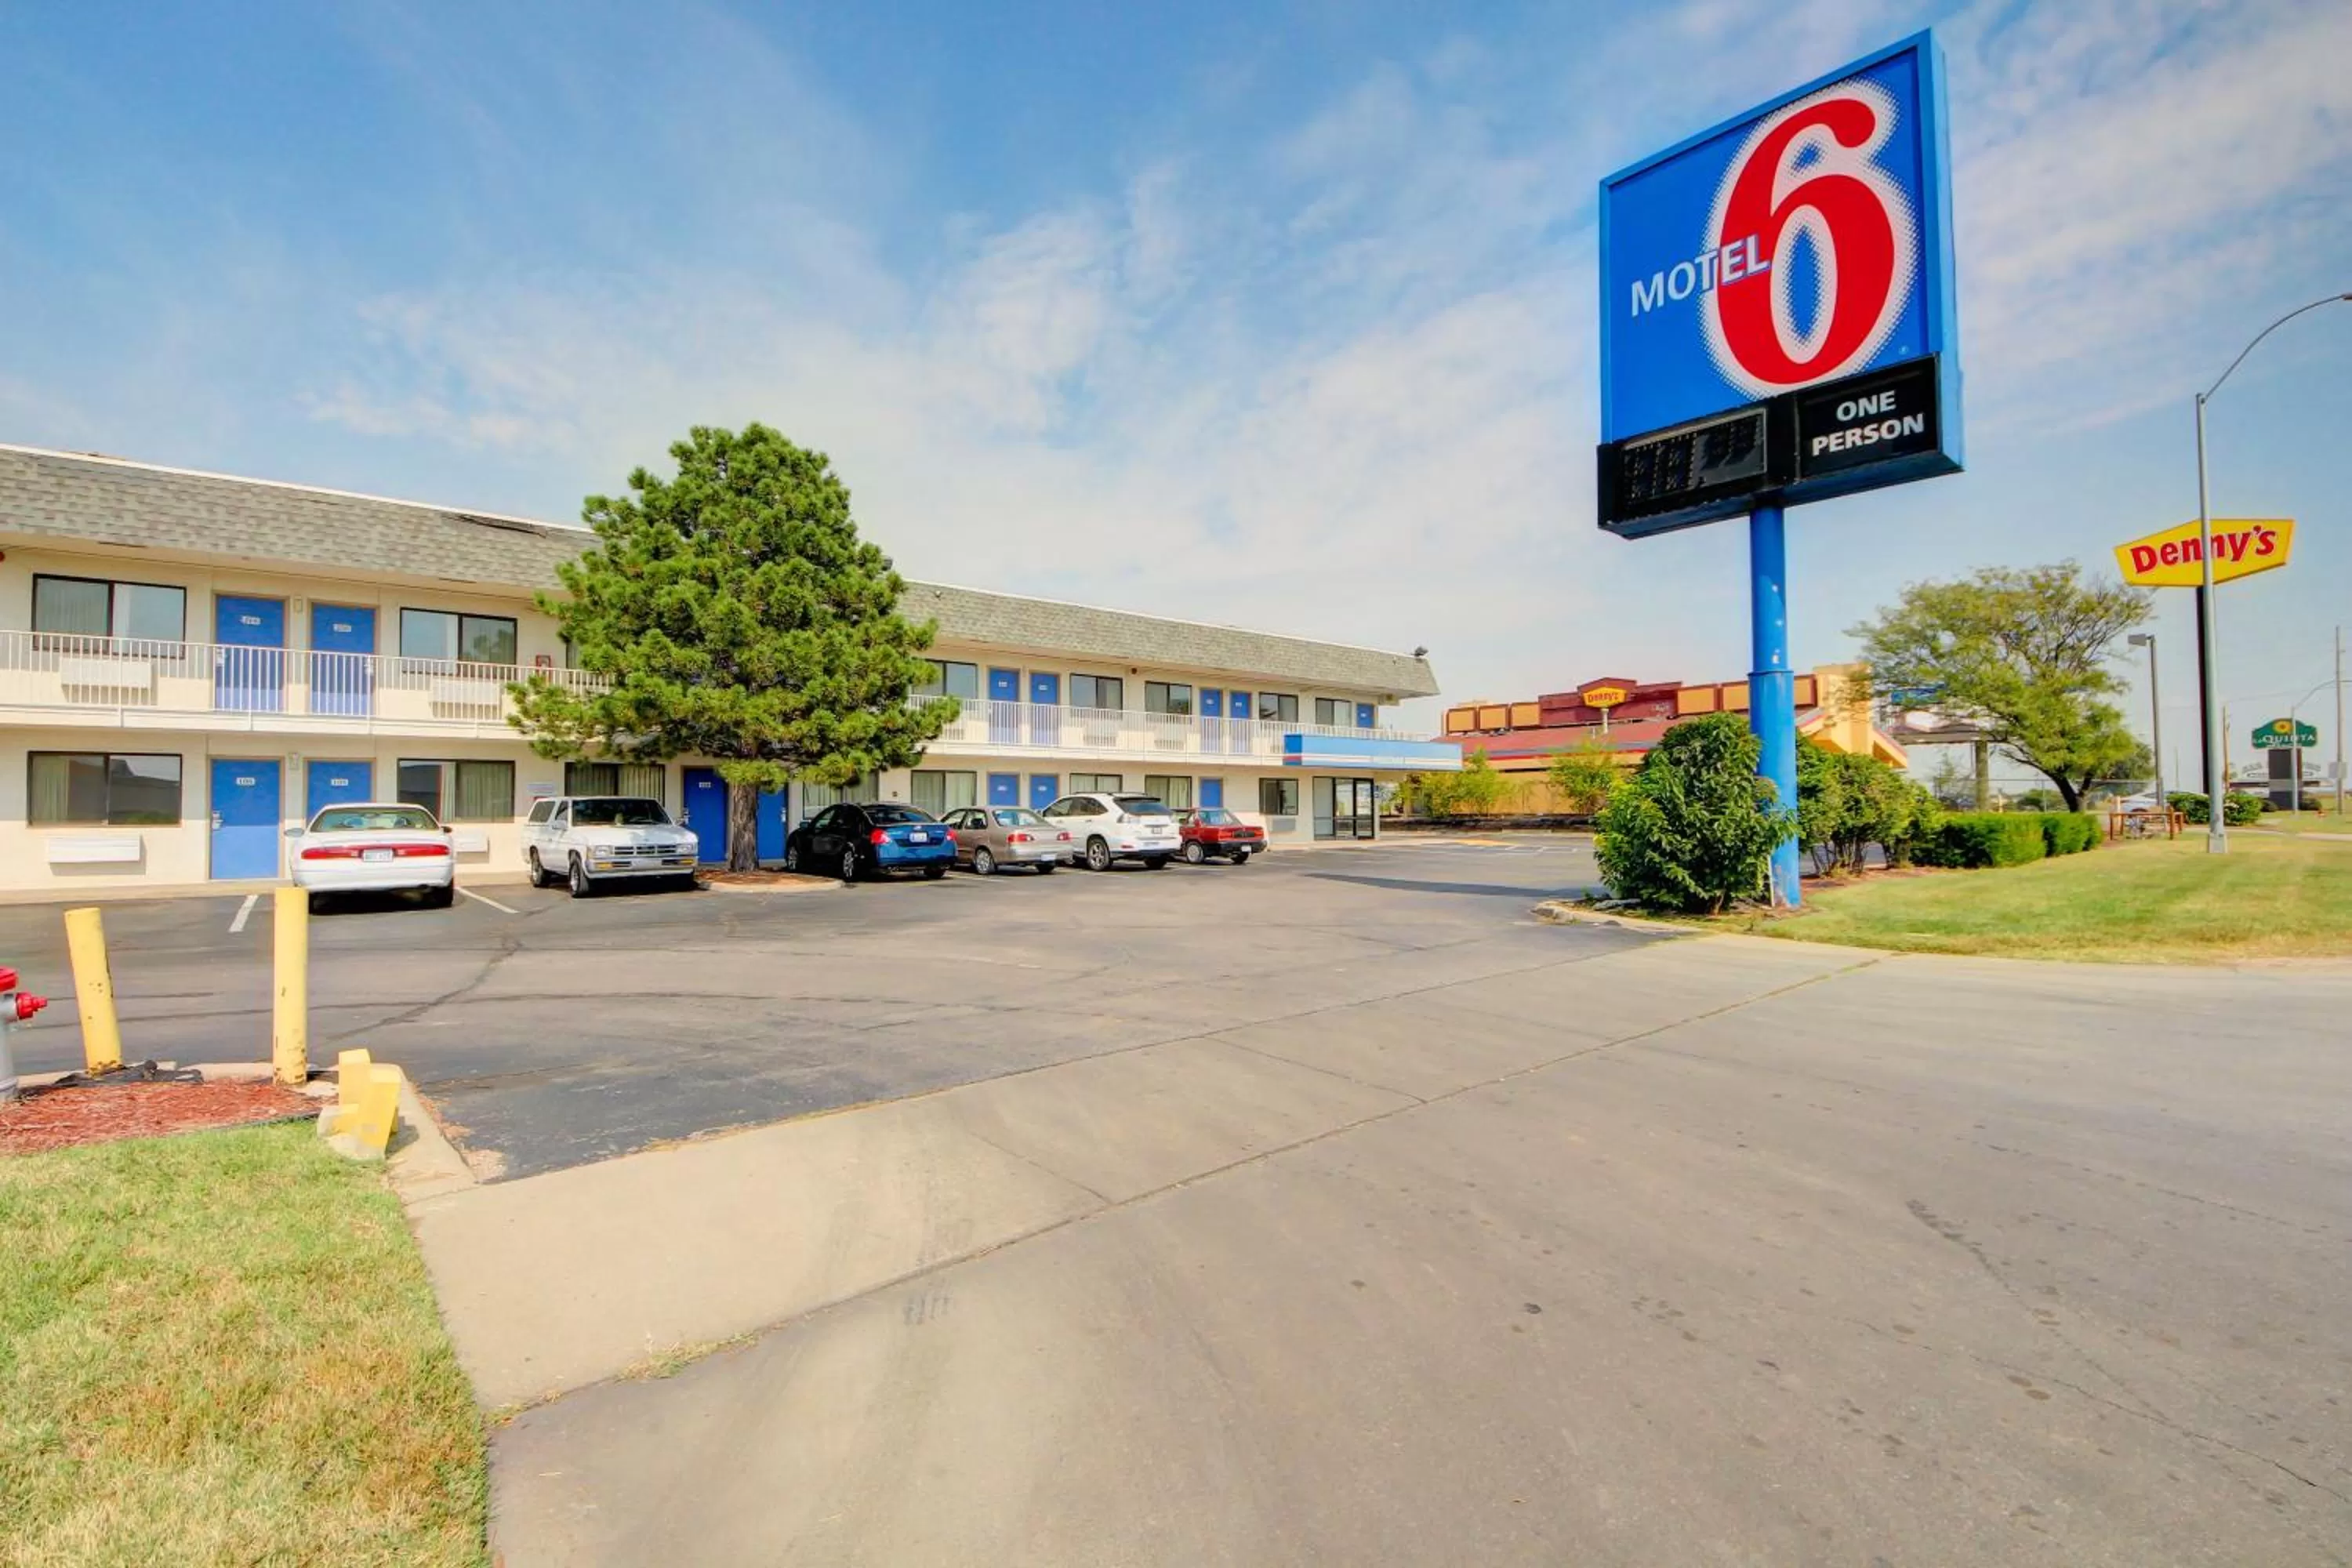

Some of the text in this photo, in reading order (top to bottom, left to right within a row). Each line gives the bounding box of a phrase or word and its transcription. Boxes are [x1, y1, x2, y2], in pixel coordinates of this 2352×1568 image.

[1631, 98, 1896, 385] MOTEL 6
[1836, 390, 1896, 422] ONE
[1812, 412, 1925, 457] PERSON
[2129, 524, 2277, 575] Denny's
